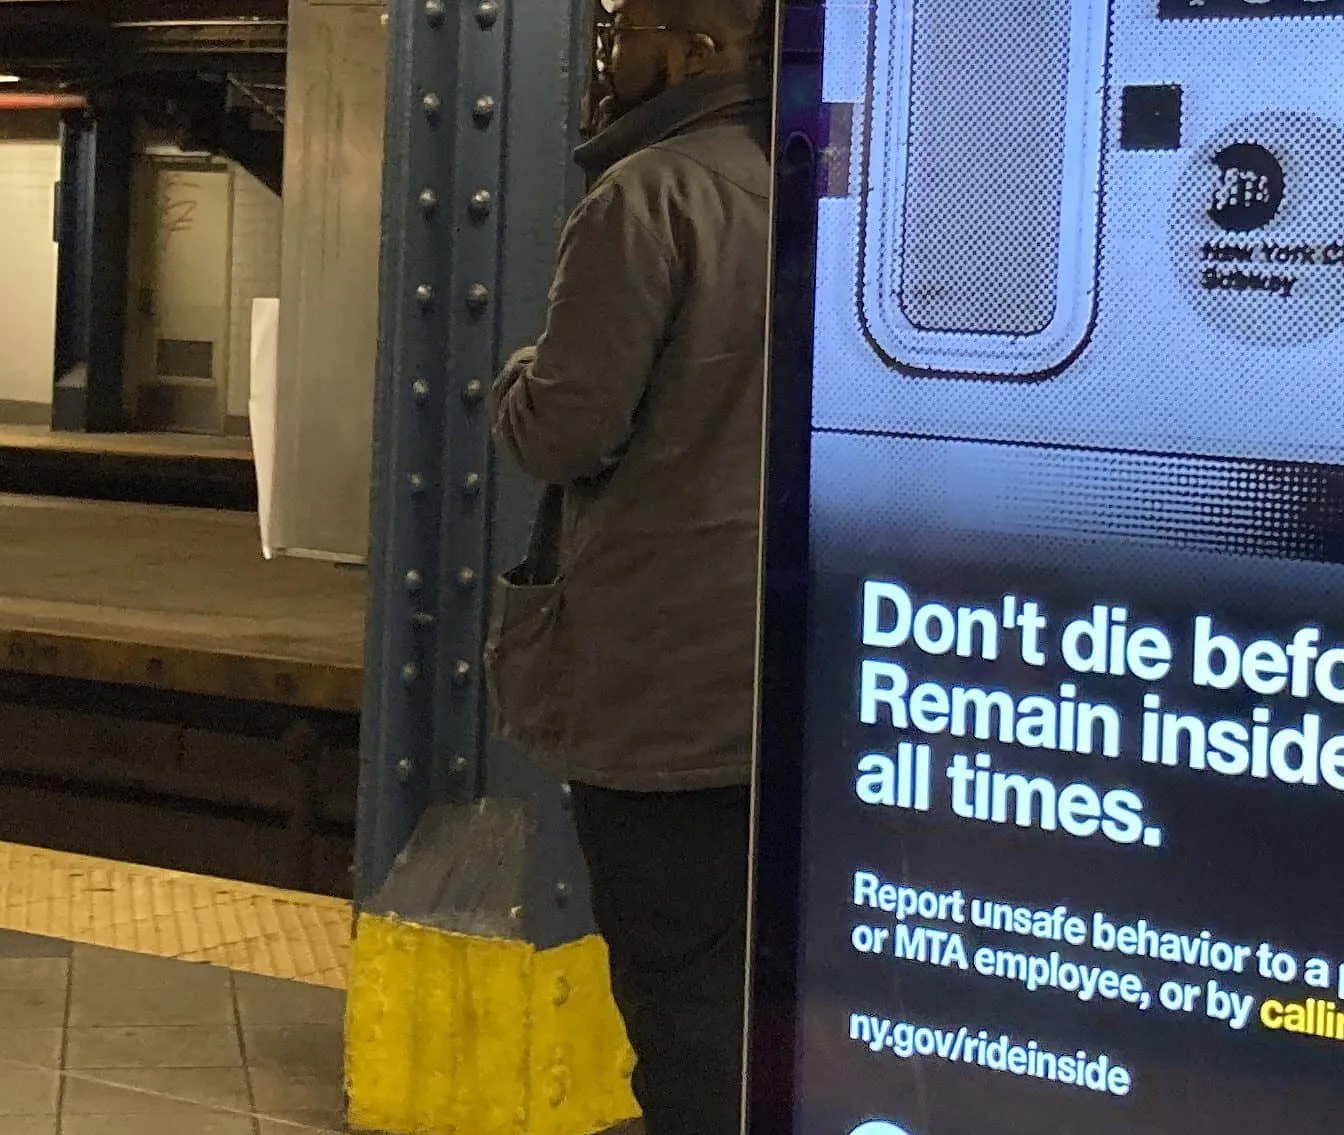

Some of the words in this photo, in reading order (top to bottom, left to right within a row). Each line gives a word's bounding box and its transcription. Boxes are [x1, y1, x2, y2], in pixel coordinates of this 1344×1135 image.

[862, 581, 1047, 666] Don't
[1062, 604, 1172, 681] die
[859, 659, 1120, 758] Remain
[856, 741, 931, 811] all
[947, 752, 1162, 847] times.
[852, 923, 889, 955] or
[894, 923, 969, 971] MTA
[974, 946, 1152, 1010] employee,
[1159, 980, 1201, 1013] or
[1206, 979, 1254, 1030] by
[854, 871, 966, 920] Report
[970, 898, 1087, 946] unsafe
[1092, 912, 1252, 974] behavior
[1256, 943, 1297, 983] to
[1304, 957, 1329, 988] a
[848, 1012, 1132, 1097] ny.gov/rideinside
